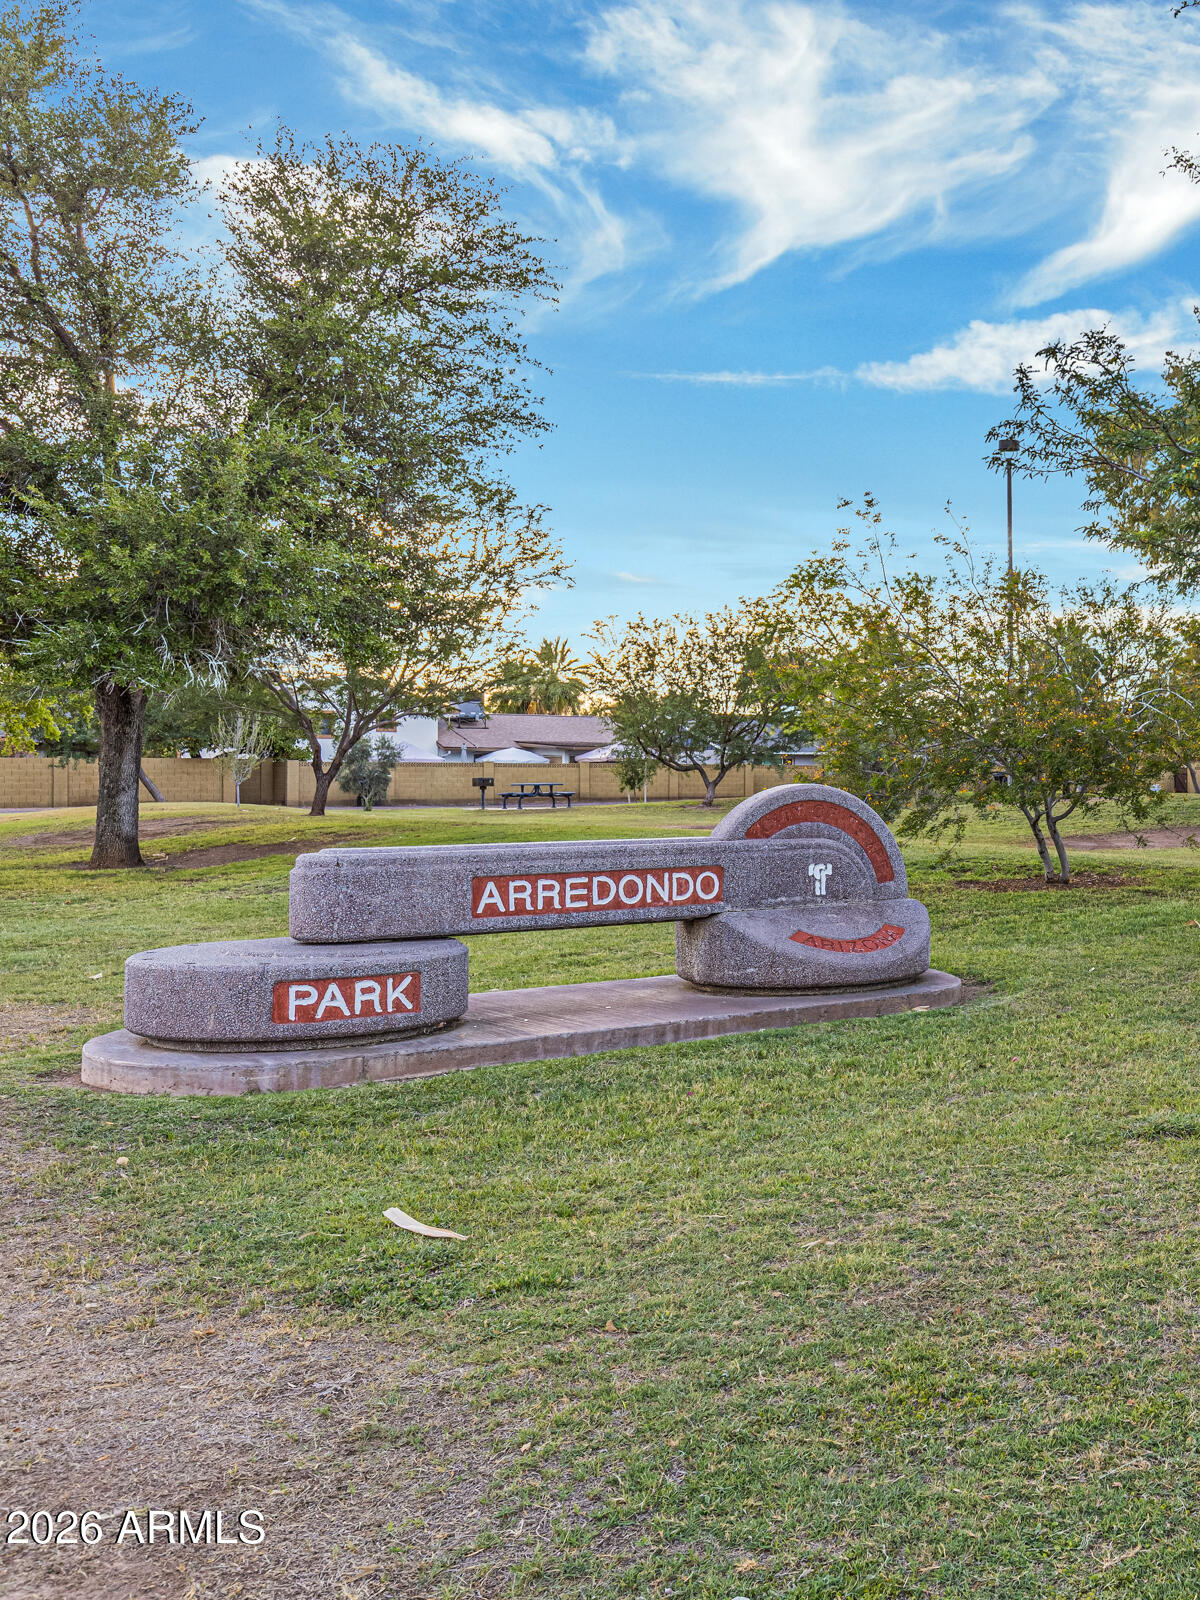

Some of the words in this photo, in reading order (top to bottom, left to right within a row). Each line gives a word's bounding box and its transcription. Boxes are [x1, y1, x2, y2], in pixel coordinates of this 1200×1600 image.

[476, 870, 720, 914] ARREDONDO
[803, 929, 899, 953] ARIZONA
[287, 974, 413, 1022] PARK
